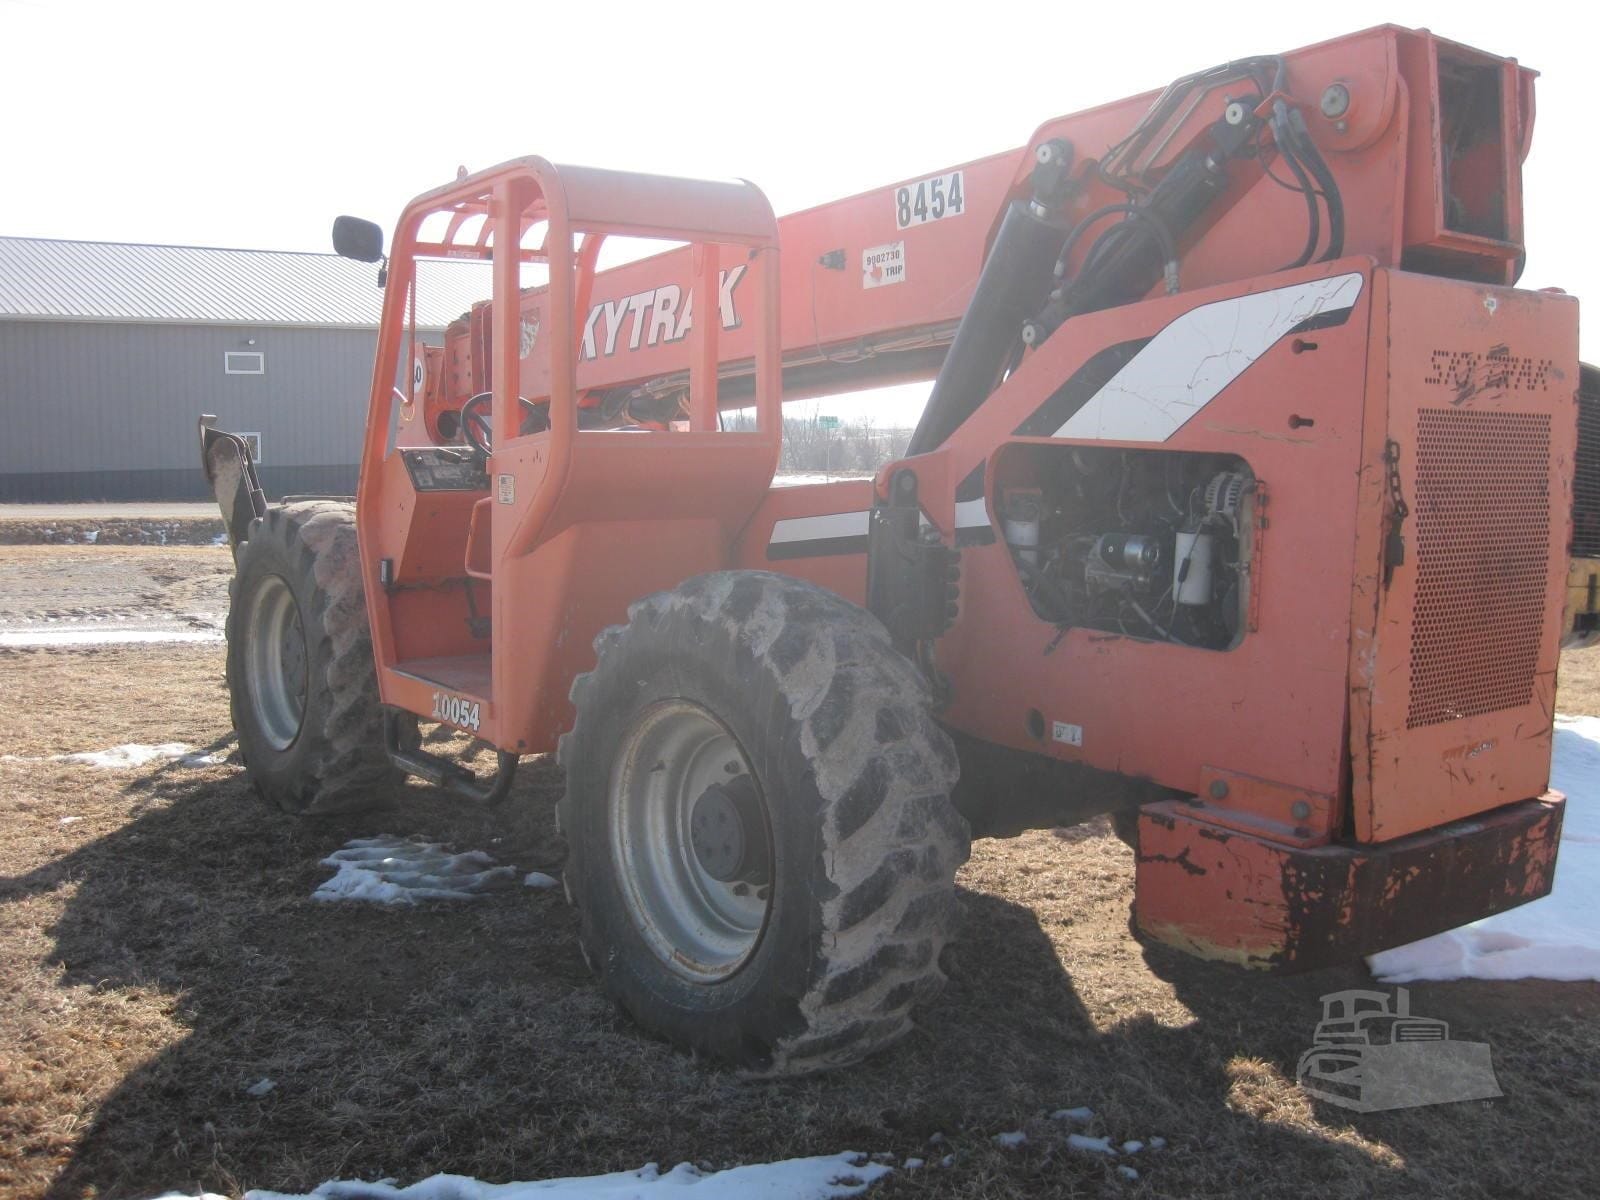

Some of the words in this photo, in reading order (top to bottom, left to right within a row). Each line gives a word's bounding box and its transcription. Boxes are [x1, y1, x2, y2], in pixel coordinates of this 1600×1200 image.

[897, 173, 963, 227] 8454
[886, 265, 903, 277] TRIP
[578, 265, 748, 360] KYTRAK
[431, 691, 481, 732] 10054
